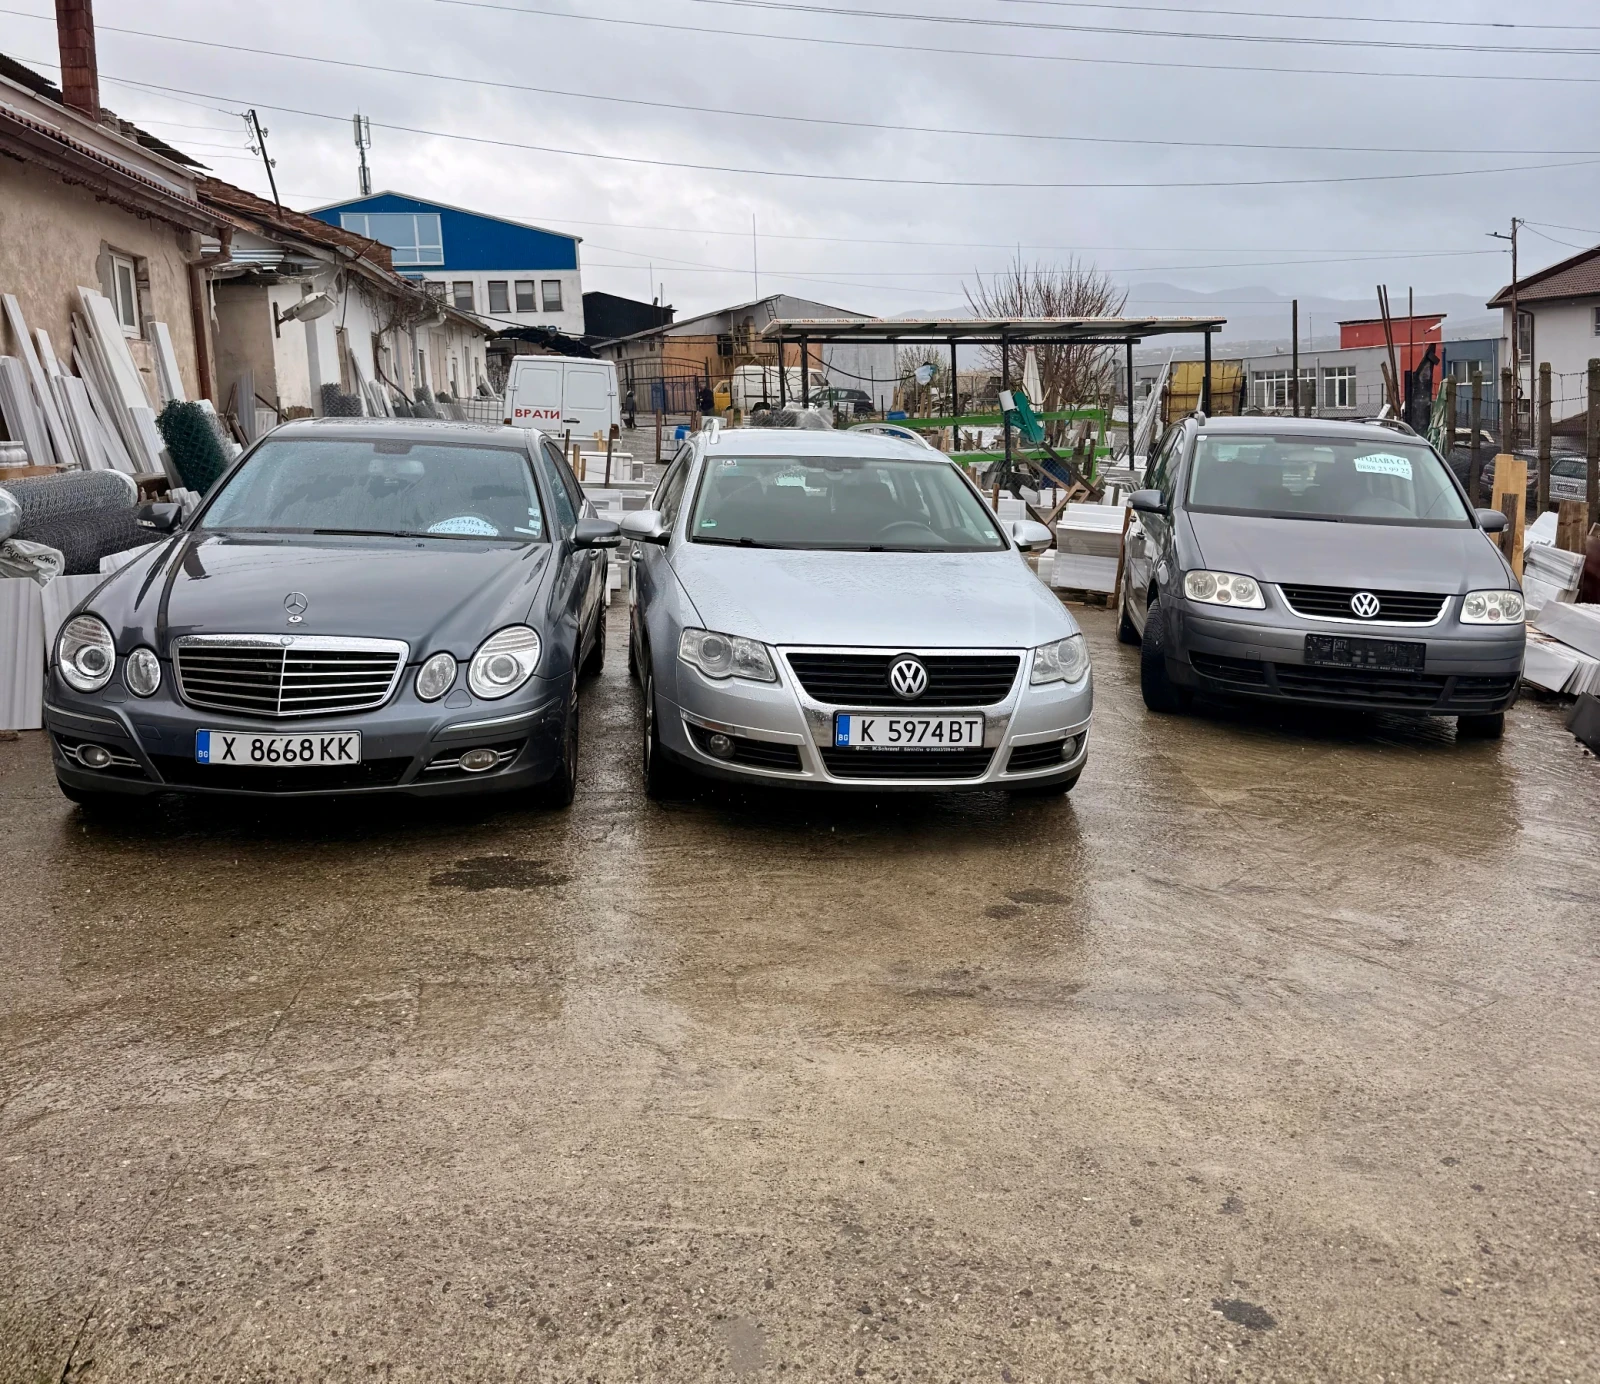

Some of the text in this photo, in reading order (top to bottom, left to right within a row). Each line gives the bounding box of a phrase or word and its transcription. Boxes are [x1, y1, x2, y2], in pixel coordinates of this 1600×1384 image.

[515, 409, 560, 420] ВРАТИ
[861, 719, 875, 742] K
[838, 733, 849, 741] BG
[221, 736, 237, 761] X
[198, 750, 209, 759] BG
